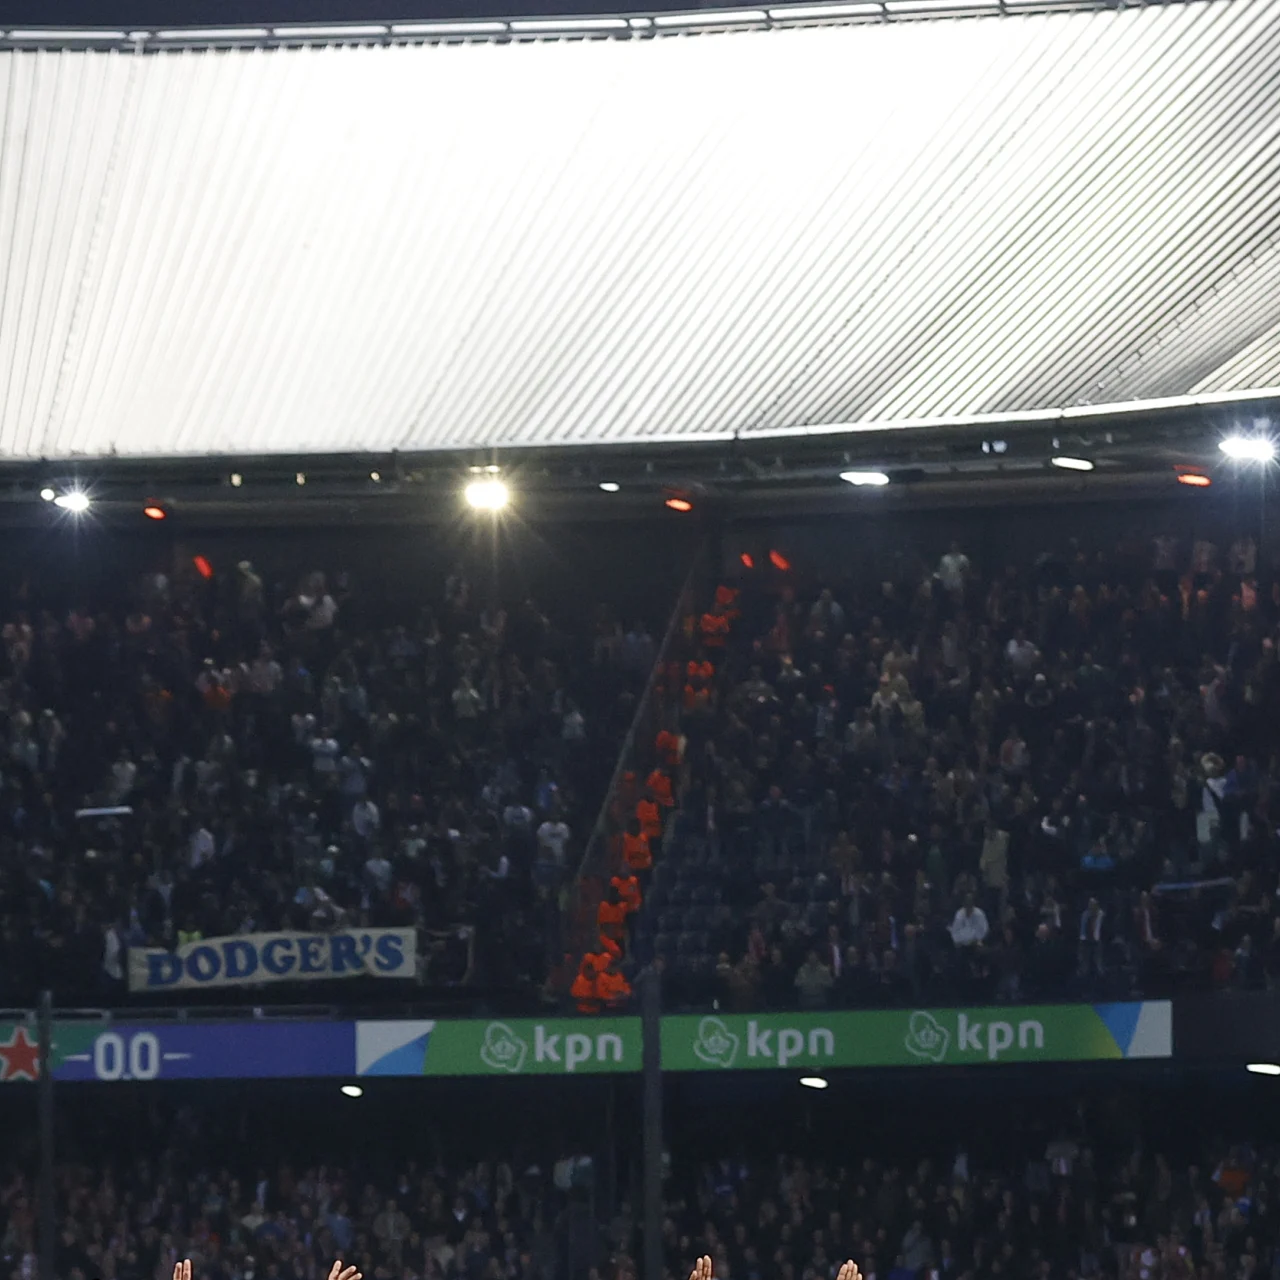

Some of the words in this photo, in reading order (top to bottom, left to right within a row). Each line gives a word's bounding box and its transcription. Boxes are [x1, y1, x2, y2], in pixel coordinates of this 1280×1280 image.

[146, 934, 404, 986] DODGER'S
[534, 1017, 624, 1072] kpn
[747, 1018, 836, 1066] kpn
[956, 1013, 1045, 1060] kpn
